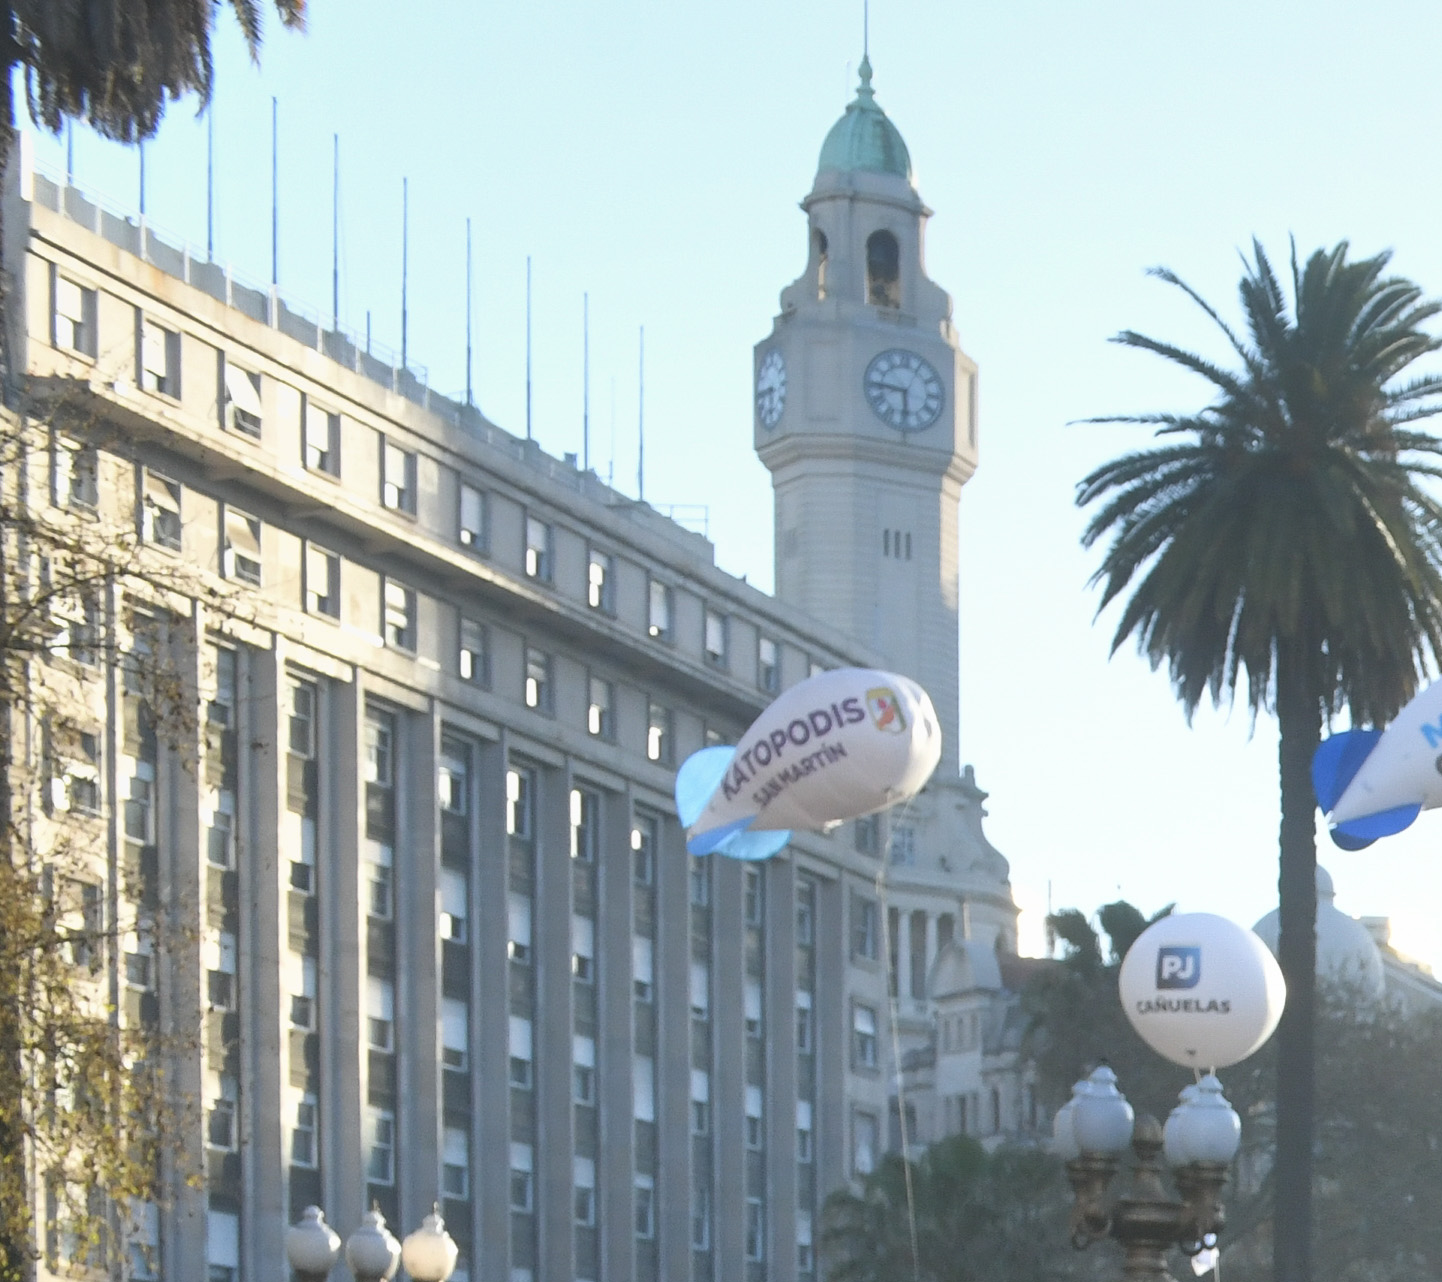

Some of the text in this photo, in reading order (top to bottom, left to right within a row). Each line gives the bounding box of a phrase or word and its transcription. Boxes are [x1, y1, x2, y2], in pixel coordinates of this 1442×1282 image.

[719, 696, 867, 801] KATOPODIS
[1161, 954, 1194, 980] PJ
[1136, 993, 1231, 1015] CAÑUELAS
